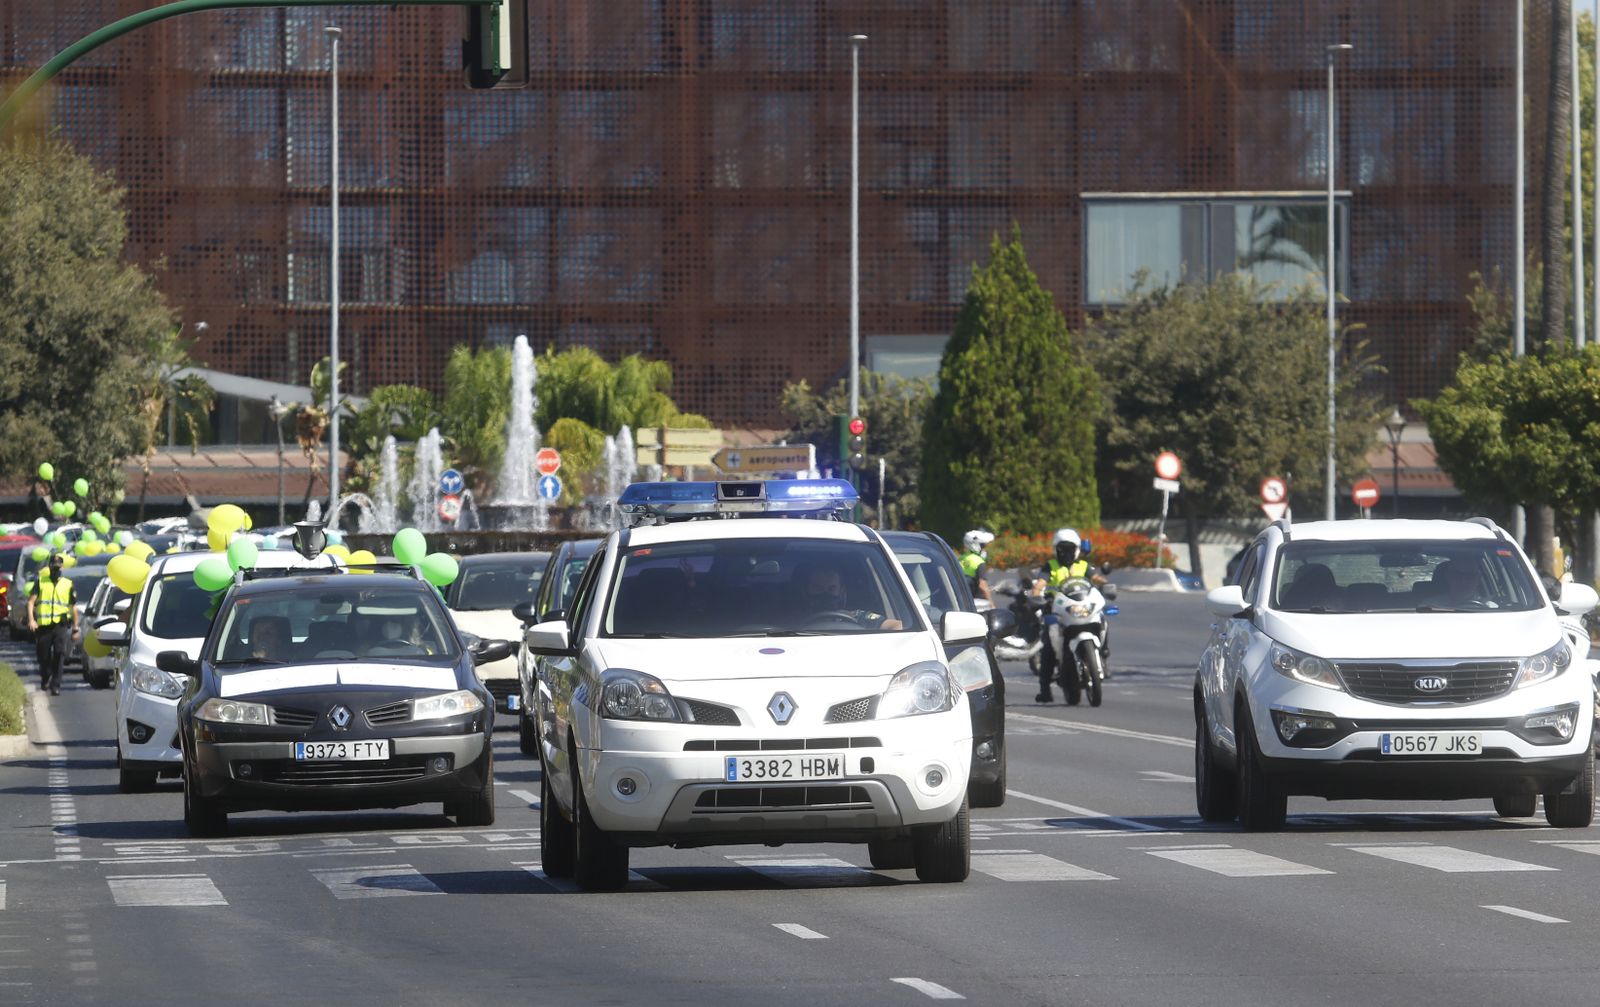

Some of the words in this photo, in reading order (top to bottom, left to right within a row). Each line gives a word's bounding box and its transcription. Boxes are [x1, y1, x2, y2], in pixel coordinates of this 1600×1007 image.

[1419, 679, 1443, 689] KIA
[305, 743, 347, 759] 9373
[353, 742, 384, 758] FTY
[1394, 736, 1438, 752] 0567
[1445, 736, 1478, 752] JKS
[741, 759, 793, 779] 3382
[800, 758, 840, 777] HBM
